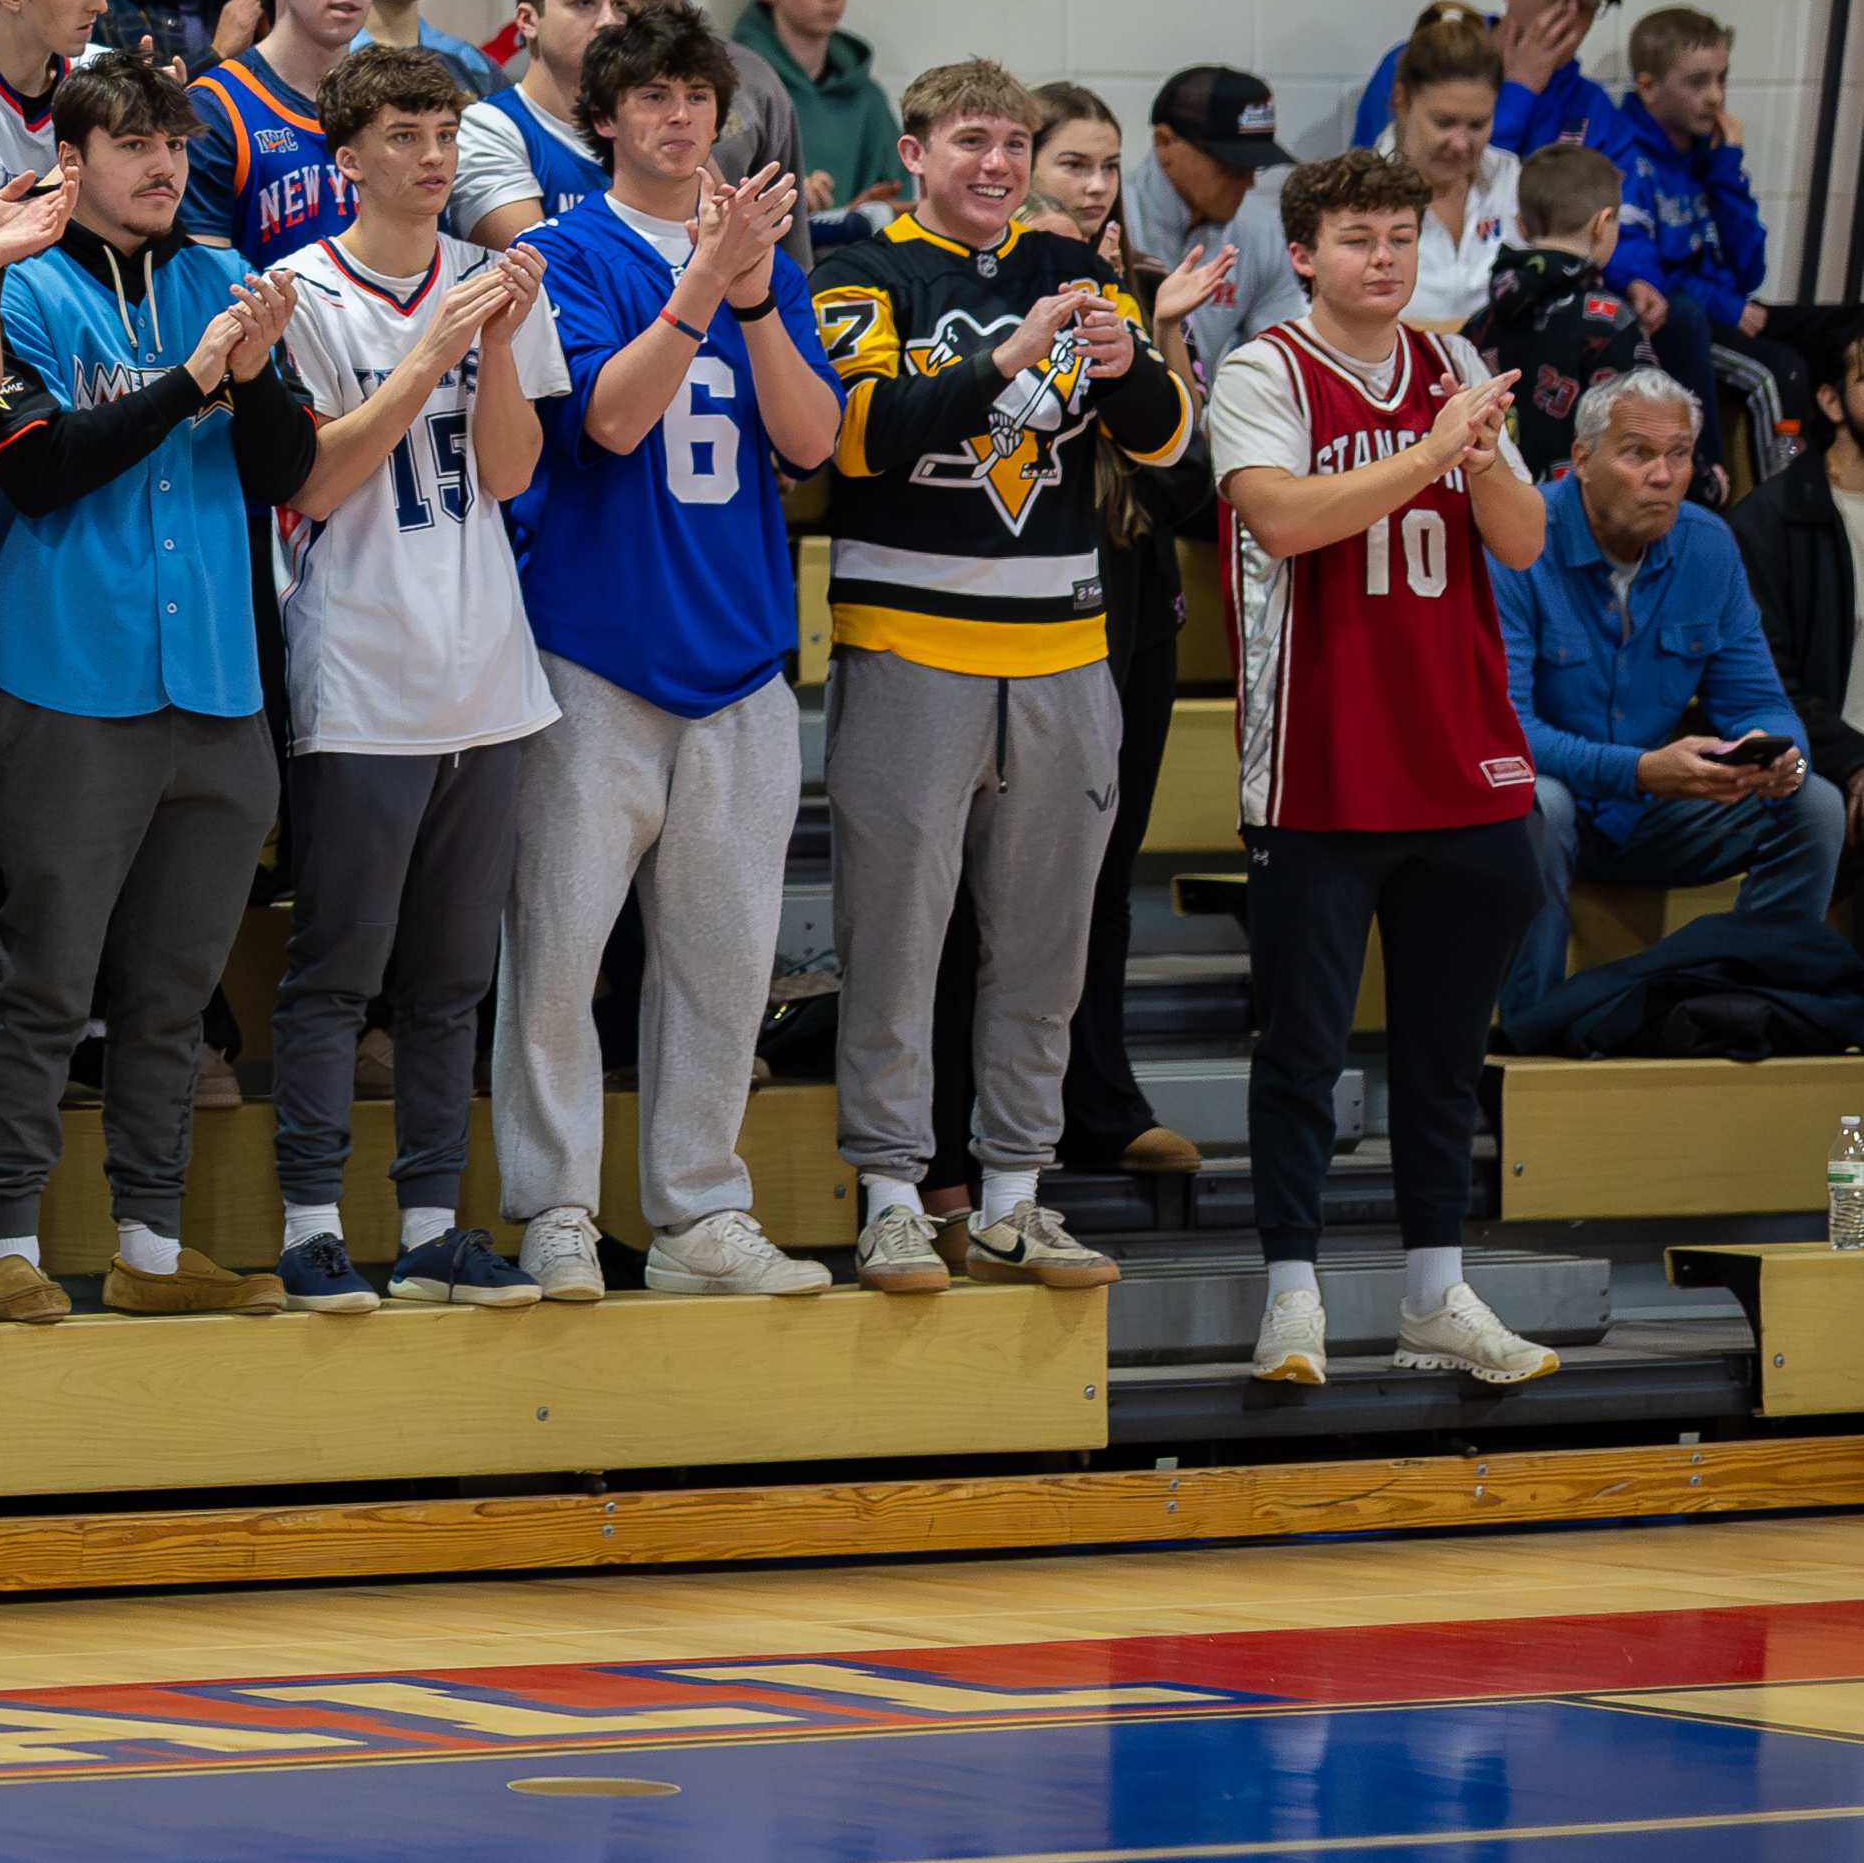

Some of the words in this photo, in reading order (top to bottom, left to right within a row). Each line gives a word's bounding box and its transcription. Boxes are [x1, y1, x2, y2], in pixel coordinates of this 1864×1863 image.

[254, 128, 299, 155] NYC
[258, 164, 320, 243] NEW
[662, 356, 741, 505] 6
[1366, 508, 1448, 599] 10
